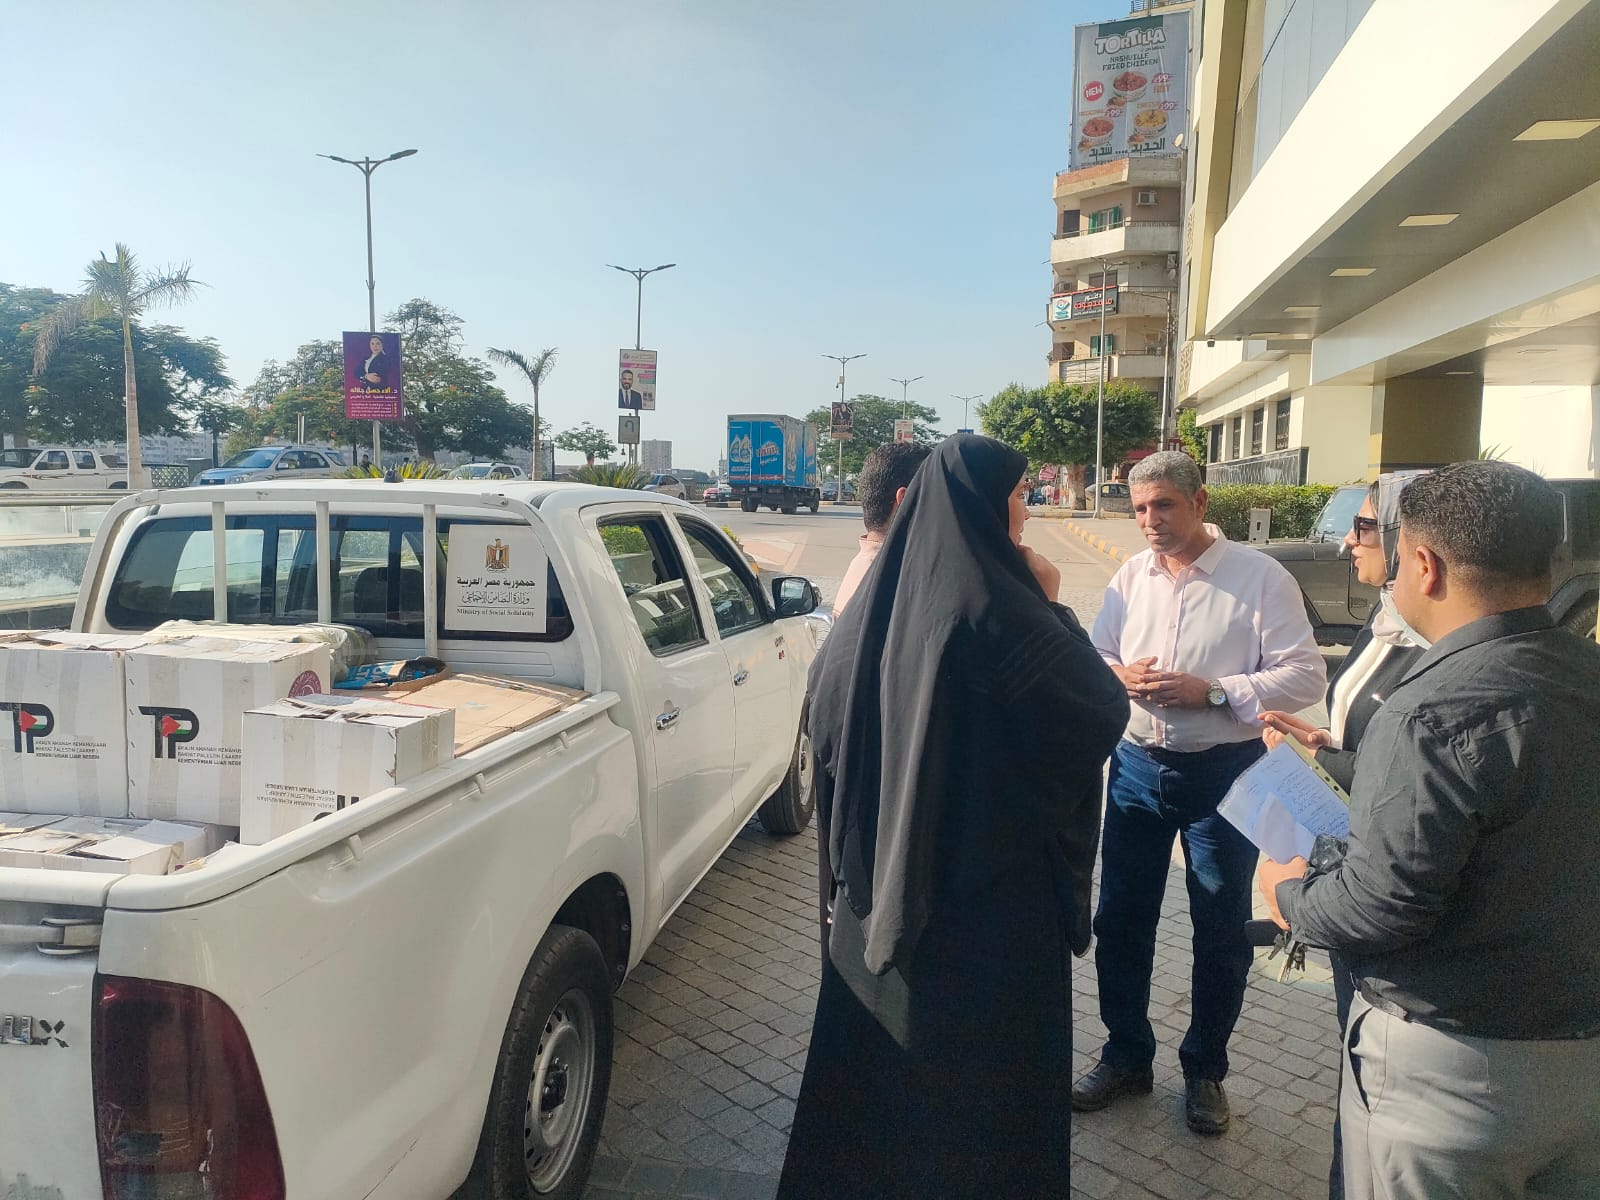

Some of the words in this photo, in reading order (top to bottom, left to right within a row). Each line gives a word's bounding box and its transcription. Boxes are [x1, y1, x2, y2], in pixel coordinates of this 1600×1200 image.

[1095, 27, 1166, 55] TORTILLA
[1110, 52, 1149, 63] NASHVILLE
[1102, 62, 1126, 71] FRIED
[1126, 58, 1159, 69] CHICKEN
[1085, 85, 1103, 98] NEW
[1089, 142, 1113, 160] شديد
[1130, 138, 1166, 156] الجديد
[456, 576, 483, 588] العربية
[485, 579, 500, 588] مصر
[503, 578, 536, 590] جمهورية
[456, 608, 480, 616] Ministry
